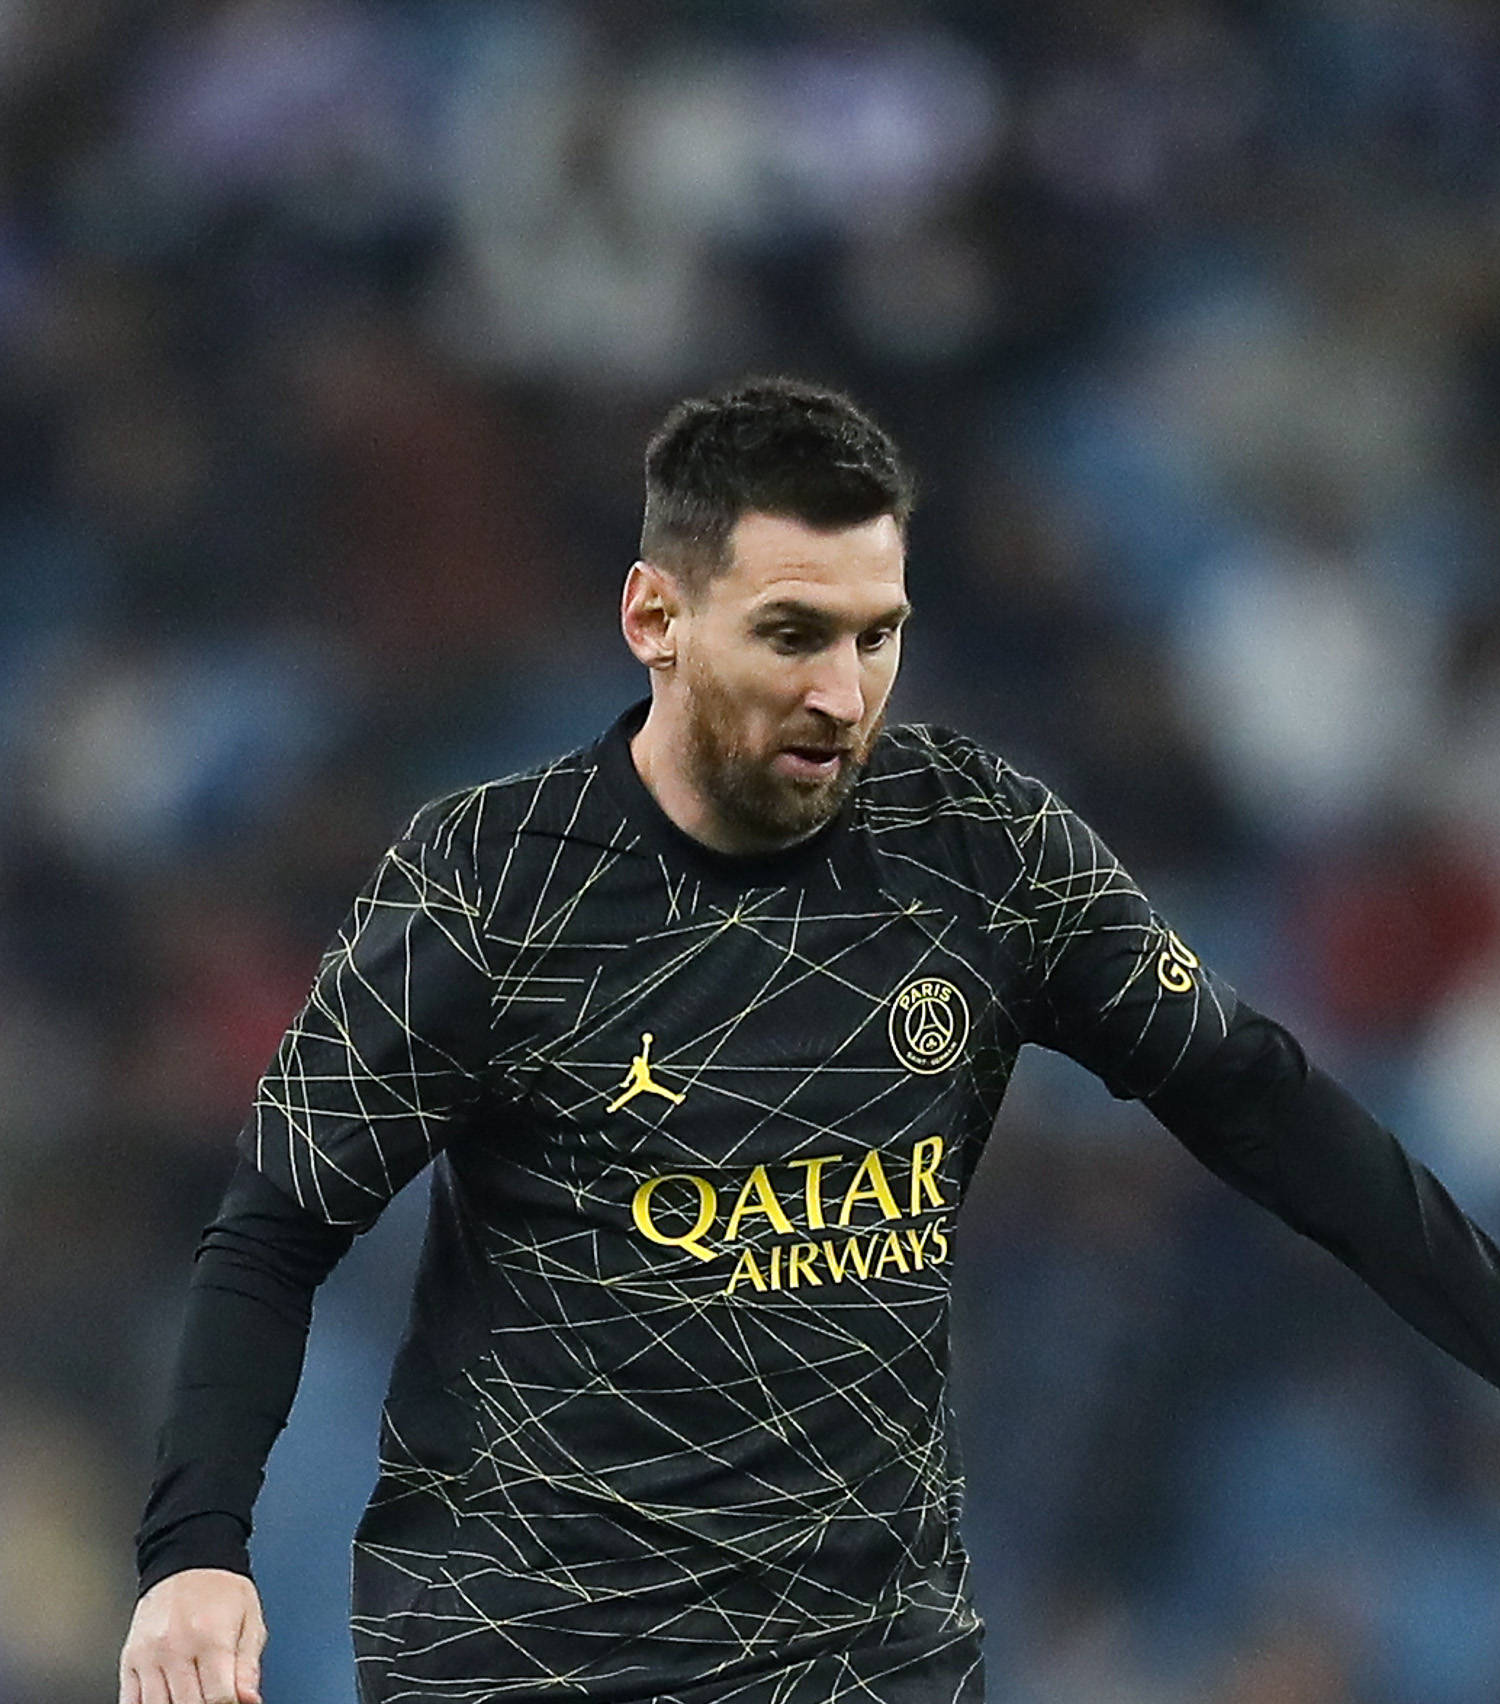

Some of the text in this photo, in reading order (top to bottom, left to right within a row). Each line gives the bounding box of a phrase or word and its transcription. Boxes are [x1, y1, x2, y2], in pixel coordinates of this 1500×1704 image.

[899, 983, 953, 1011] PARIS
[631, 1135, 946, 1264] QATAR
[724, 1215, 948, 1297] AIRWAYS
